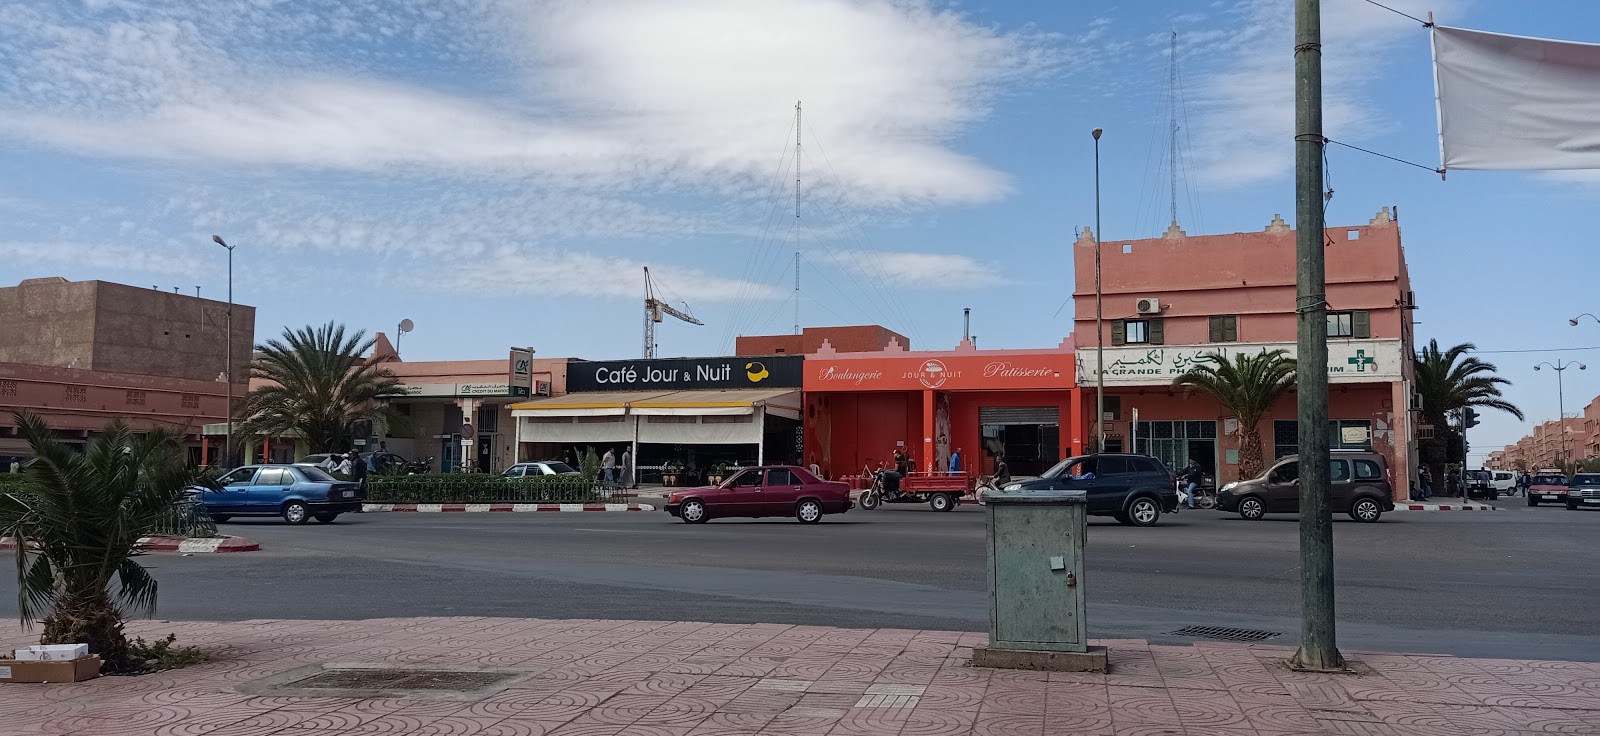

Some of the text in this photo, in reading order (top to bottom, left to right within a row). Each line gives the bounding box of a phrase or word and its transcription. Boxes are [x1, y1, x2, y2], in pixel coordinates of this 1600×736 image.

[595, 364, 731, 384] Café Jour & Nuit
[818, 366, 882, 386] Boulangerie
[983, 361, 1053, 378] Patisserie
